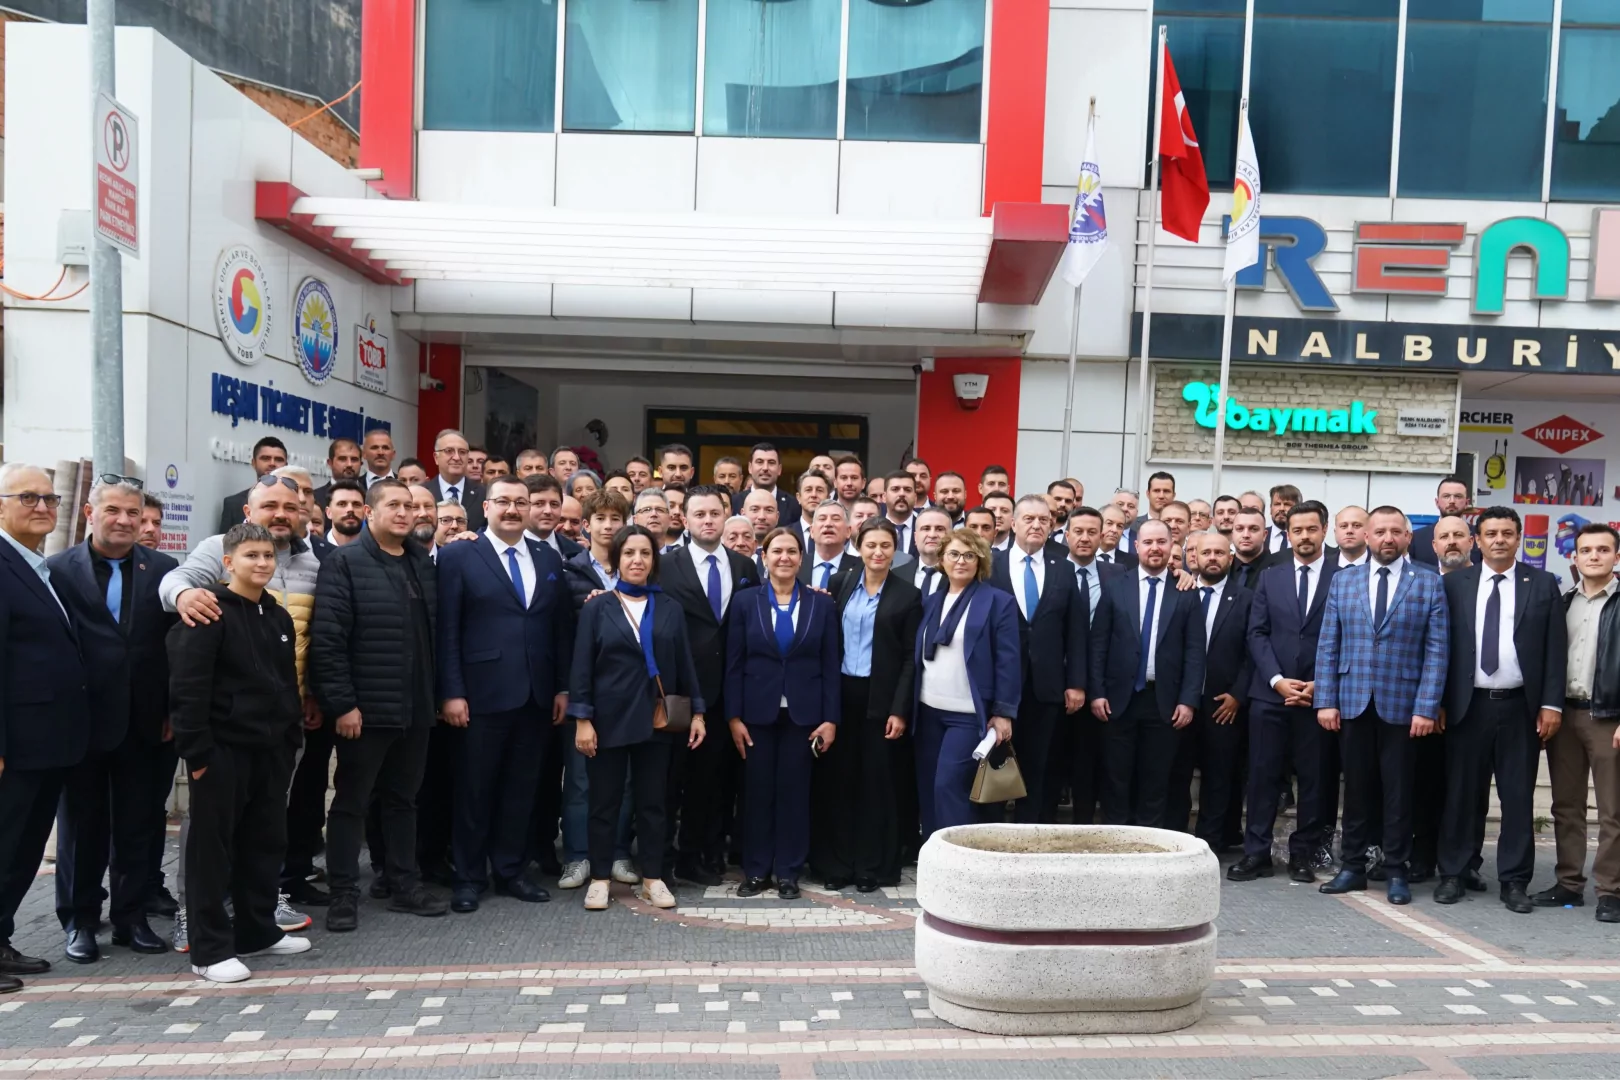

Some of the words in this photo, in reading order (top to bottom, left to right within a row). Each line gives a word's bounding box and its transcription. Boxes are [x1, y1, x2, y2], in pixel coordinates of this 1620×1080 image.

[113, 120, 124, 162] P
[220, 250, 239, 283] ODALAR
[240, 250, 248, 260] VE
[249, 254, 271, 311] BORSALAR
[237, 345, 253, 359] TOBB
[1226, 397, 1378, 435] baymak
[1534, 428, 1590, 441] KNIPEX
[1525, 540, 1545, 549] WD-40
